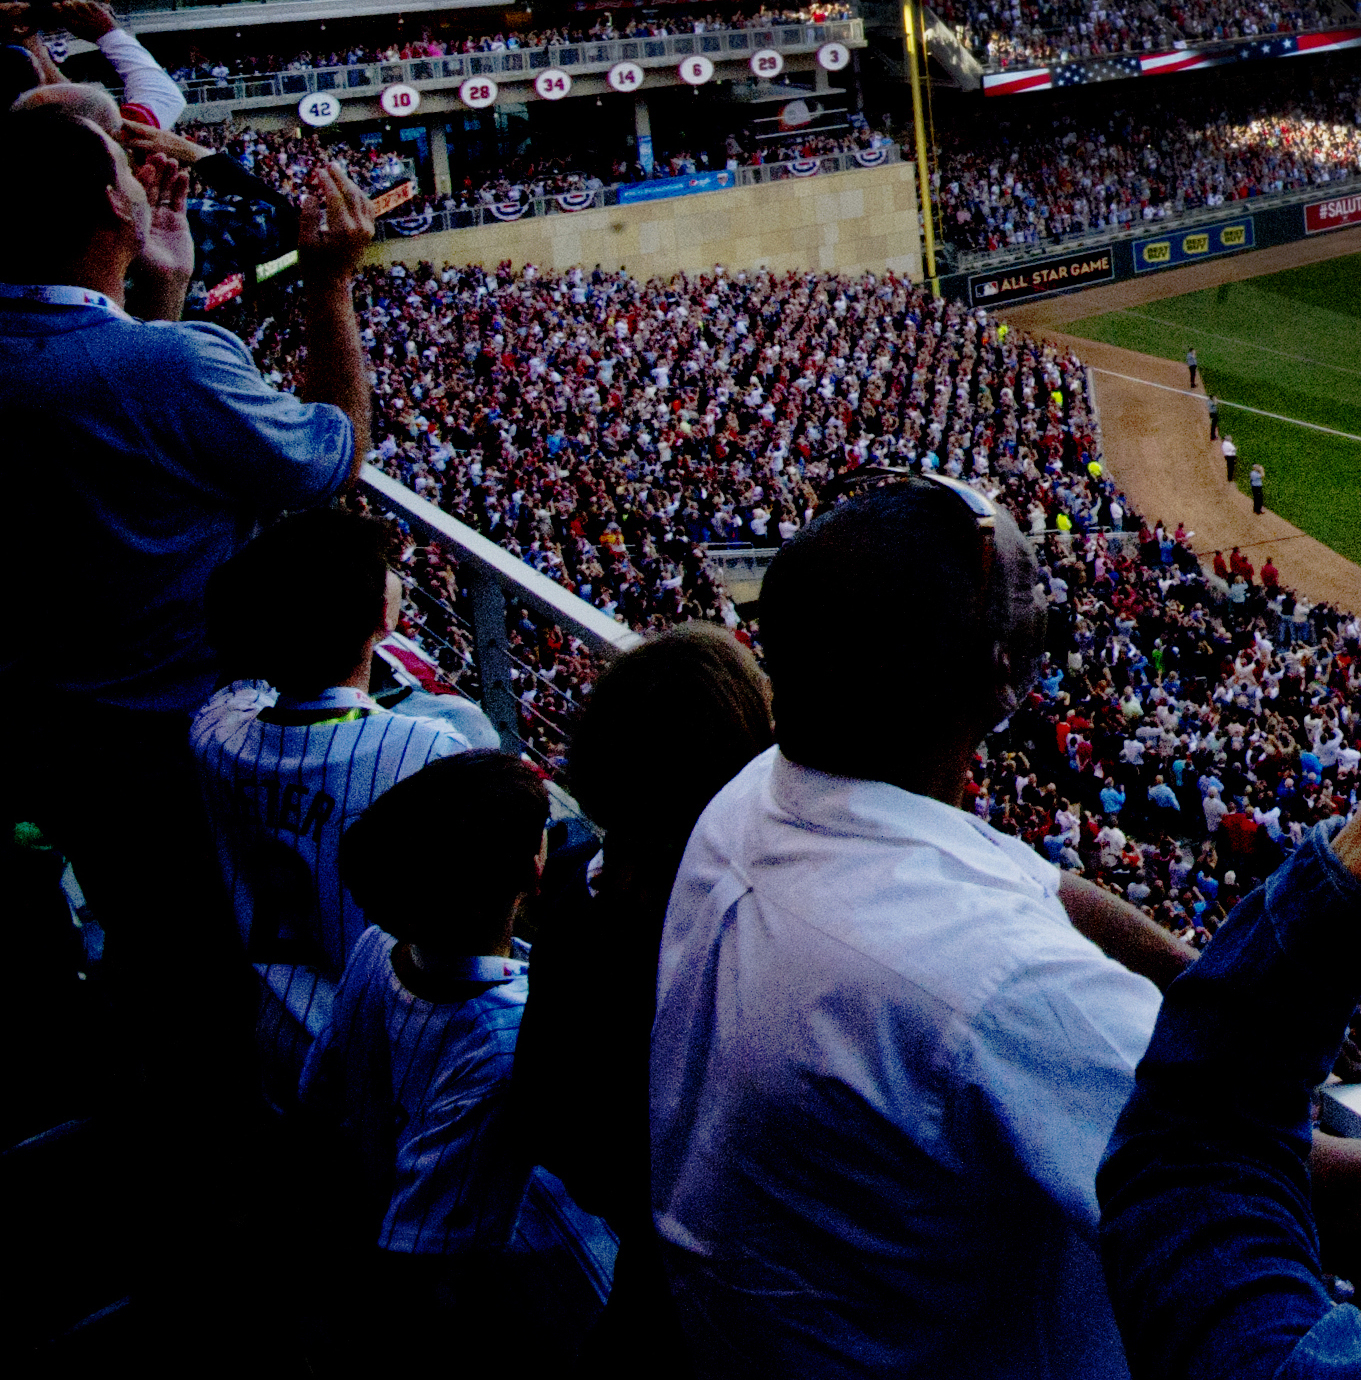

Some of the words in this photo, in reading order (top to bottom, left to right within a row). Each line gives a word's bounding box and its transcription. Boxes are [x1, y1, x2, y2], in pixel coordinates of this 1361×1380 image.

[829, 50, 839, 63] 3
[758, 57, 777, 71] 29
[617, 70, 635, 84] 14
[543, 77, 565, 92] 34
[470, 85, 490, 100] 28
[392, 93, 410, 108] 10
[309, 102, 331, 117] 42
[1223, 227, 1245, 237] BEST
[1186, 235, 1208, 245] BEST
[1225, 235, 1244, 245] BUY
[1147, 243, 1170, 254] BEST
[1187, 242, 1207, 252] BUY
[1148, 251, 1169, 262] BUY
[1002, 275, 1029, 291] ALL
[1032, 266, 1069, 285] STAR
[1071, 257, 1110, 278] GAME
